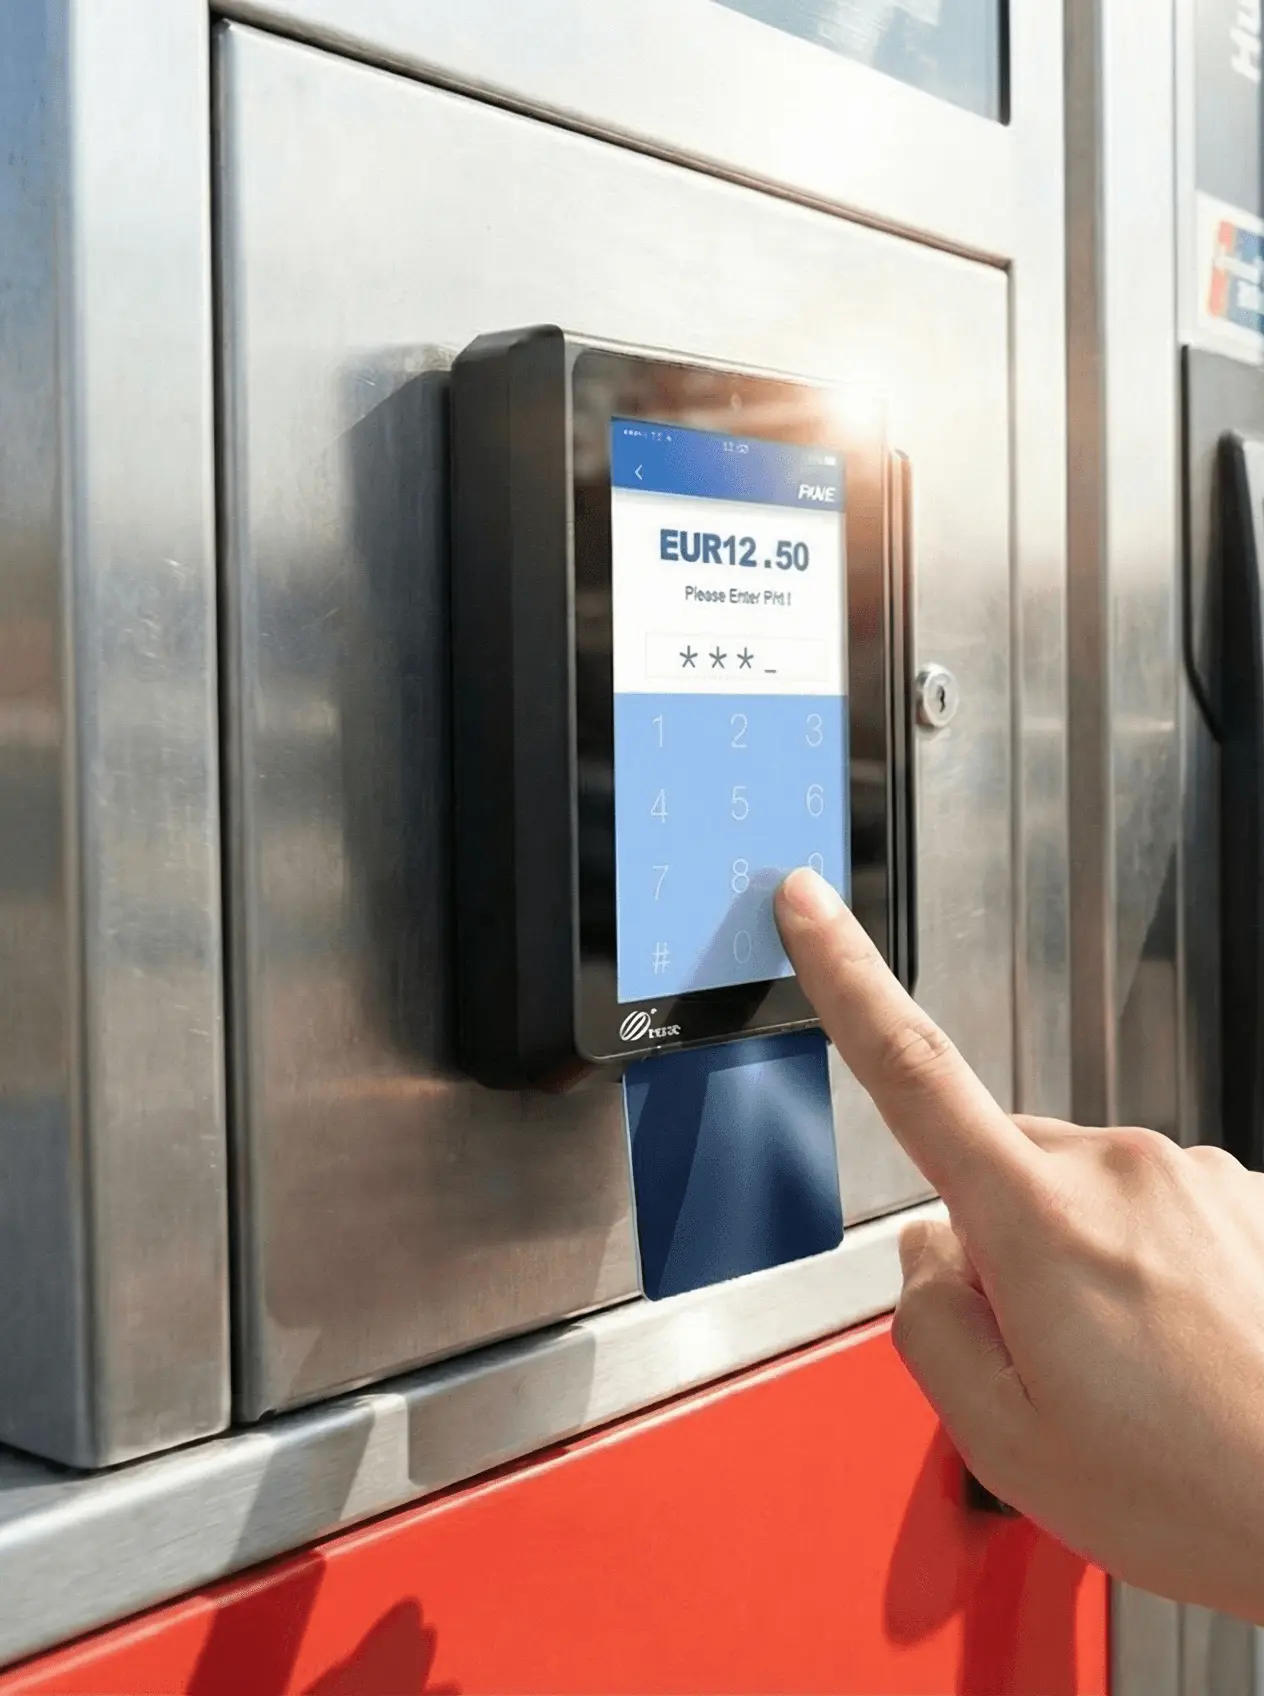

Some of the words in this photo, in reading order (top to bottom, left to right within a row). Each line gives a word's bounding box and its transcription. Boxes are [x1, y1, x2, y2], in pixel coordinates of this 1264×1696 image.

[659, 528, 810, 572] EUR12.50
[684, 585, 726, 604] Please
[729, 588, 761, 605] Enter
[652, 714, 663, 748] 1
[730, 713, 749, 749] 2
[805, 713, 824, 748] 3
[650, 789, 669, 824] 4
[731, 785, 751, 821] 5
[806, 784, 824, 818] 6
[652, 864, 669, 901] 7
[731, 858, 750, 894] 8
[733, 930, 752, 964] 0
